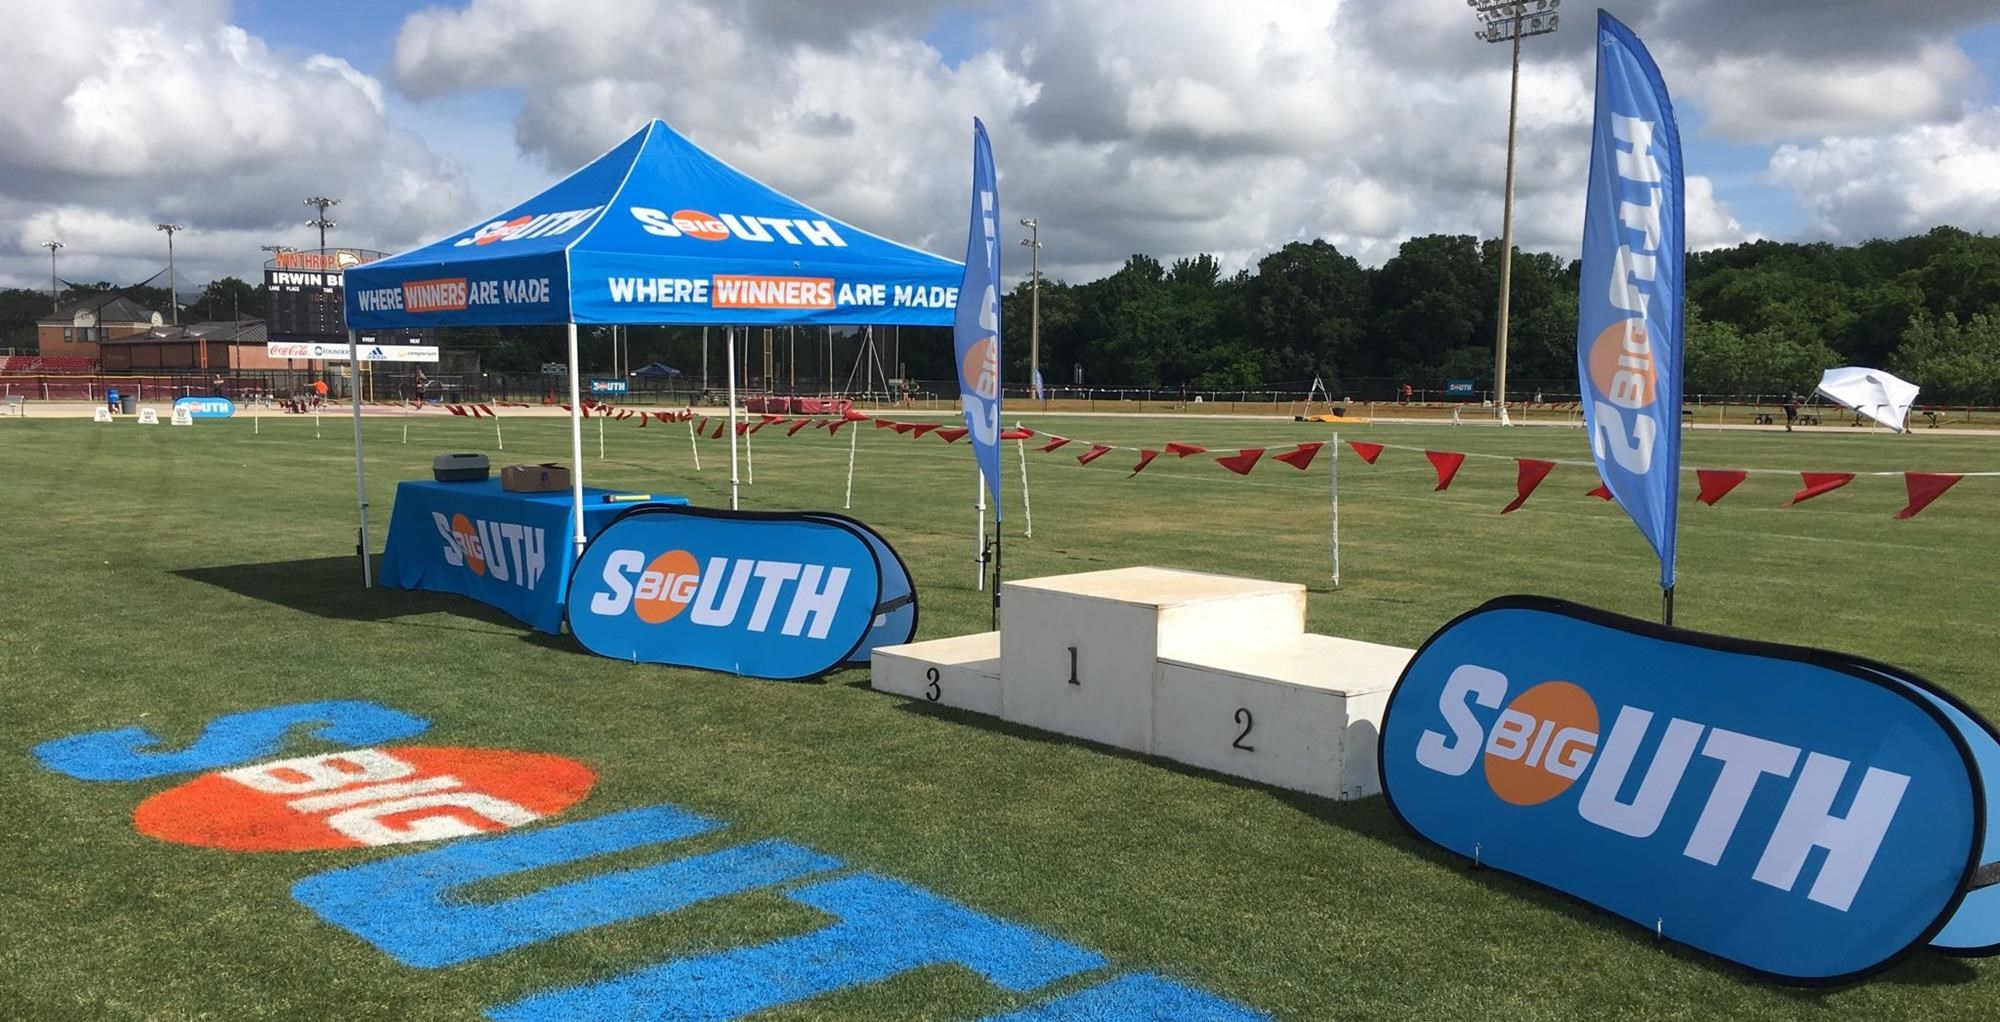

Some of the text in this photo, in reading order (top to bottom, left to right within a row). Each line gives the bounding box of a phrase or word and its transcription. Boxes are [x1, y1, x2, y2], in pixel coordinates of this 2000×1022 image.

[630, 206, 848, 247] BIG SOUTH
[273, 272, 322, 286] IRWIN
[275, 252, 335, 268] WINTHROP
[358, 278, 550, 311] WHERE WINNERS ARE MADE
[608, 277, 960, 308] WHERE WINNERS ARE MADE
[432, 512, 546, 591] BIG SOUTH
[590, 549, 852, 640] BIG SOUTH
[926, 667, 941, 701] 3
[1067, 646, 1081, 687] 1
[1232, 707, 1255, 752] 2
[220, 747, 541, 847] BIG
[1415, 664, 1911, 913] BIG SOUTH
